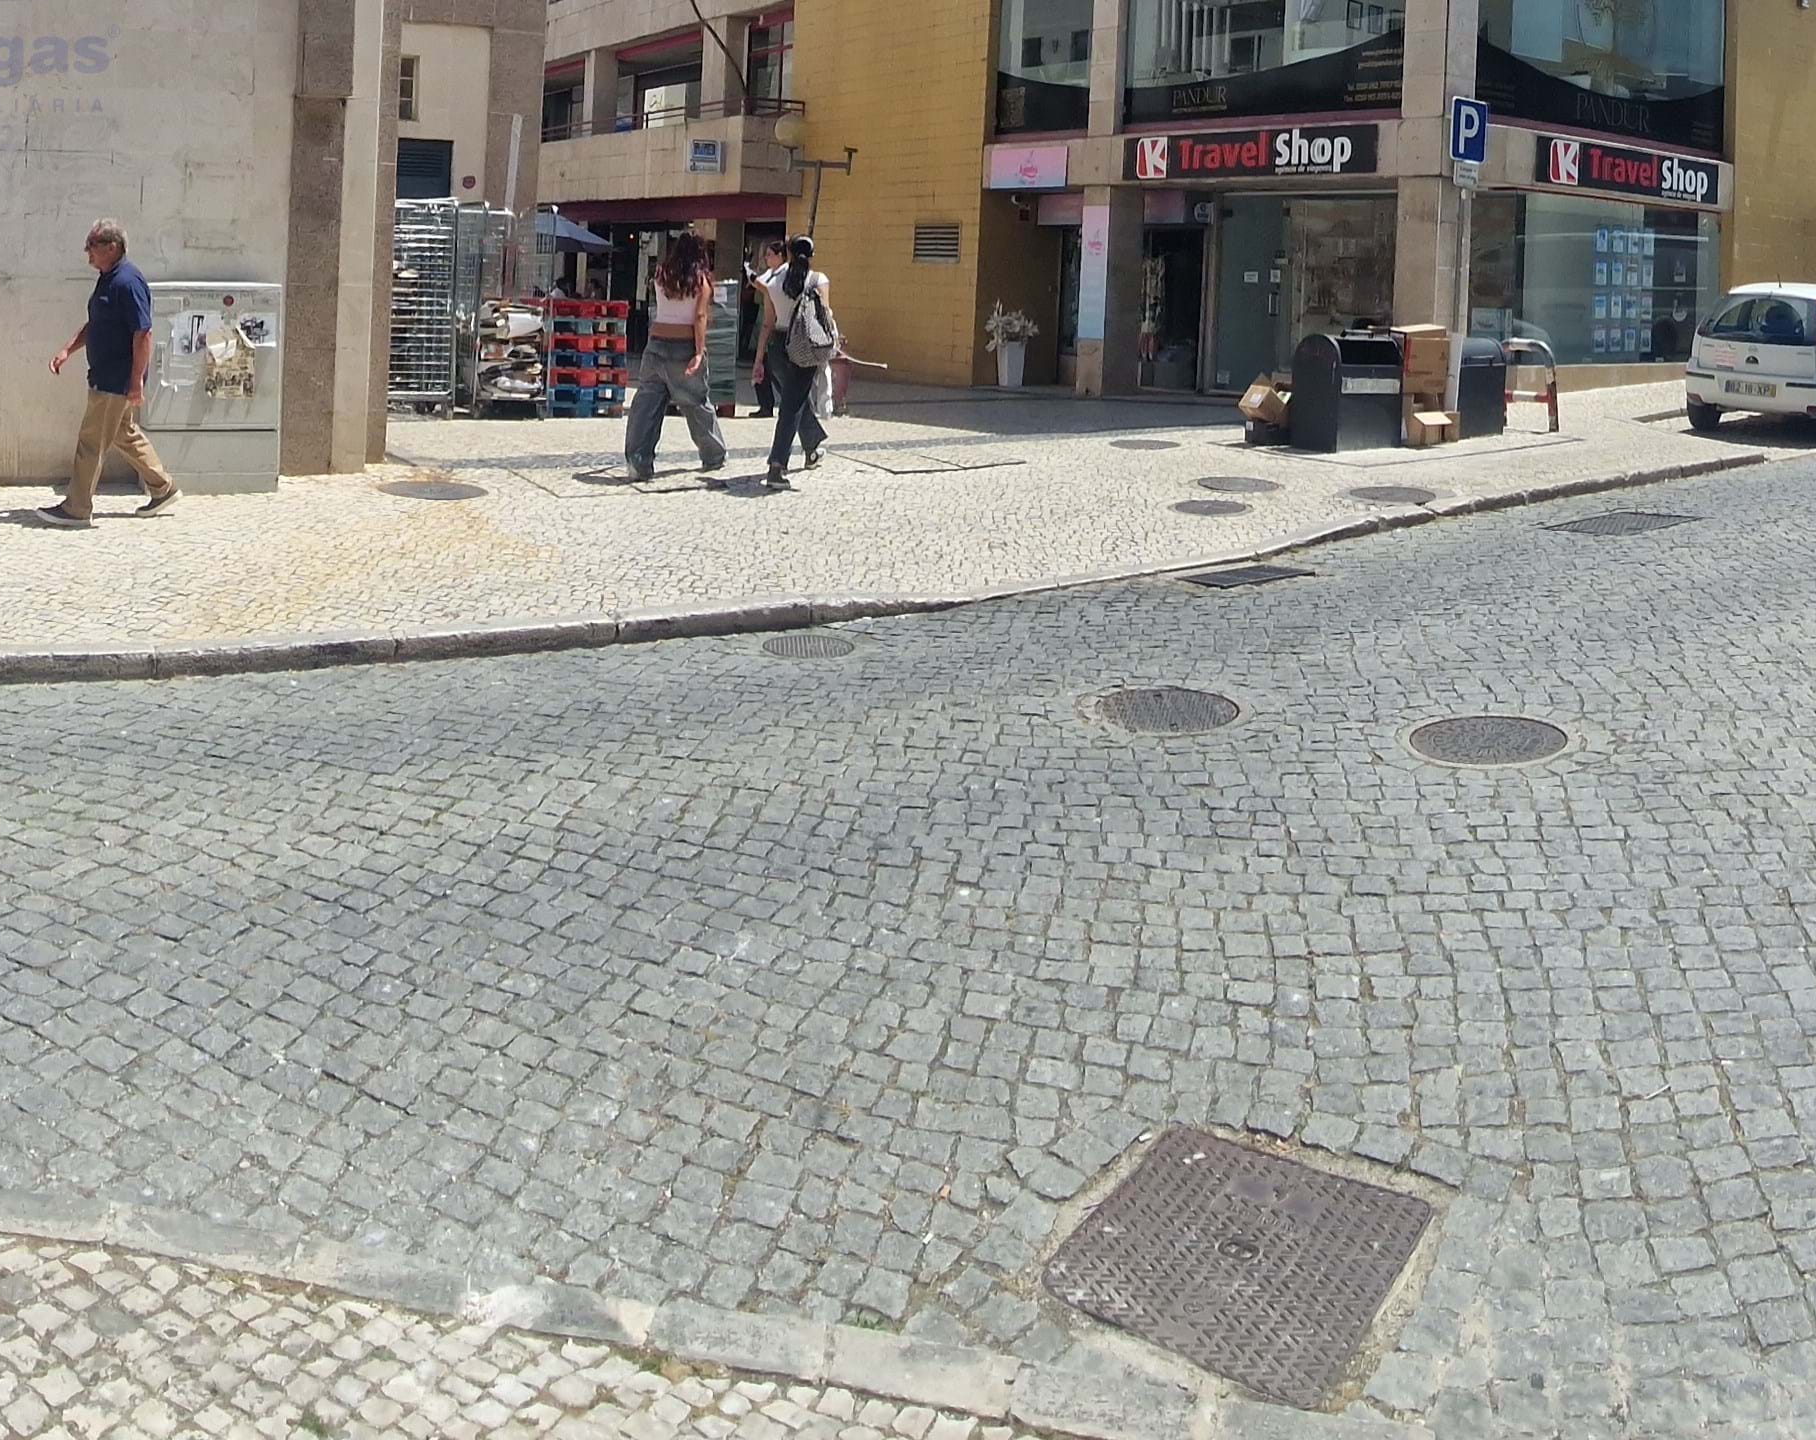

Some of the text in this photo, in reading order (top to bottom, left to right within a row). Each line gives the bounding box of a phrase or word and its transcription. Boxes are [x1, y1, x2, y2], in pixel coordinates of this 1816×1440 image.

[1172, 86, 1228, 107] PANDUR
[1576, 92, 1650, 133] PANDUR
[1179, 131, 1272, 171] Travel
[1274, 128, 1353, 174] Shop
[1458, 104, 1481, 154] P
[1589, 148, 1659, 188] Travel
[1661, 157, 1709, 202] Shop
